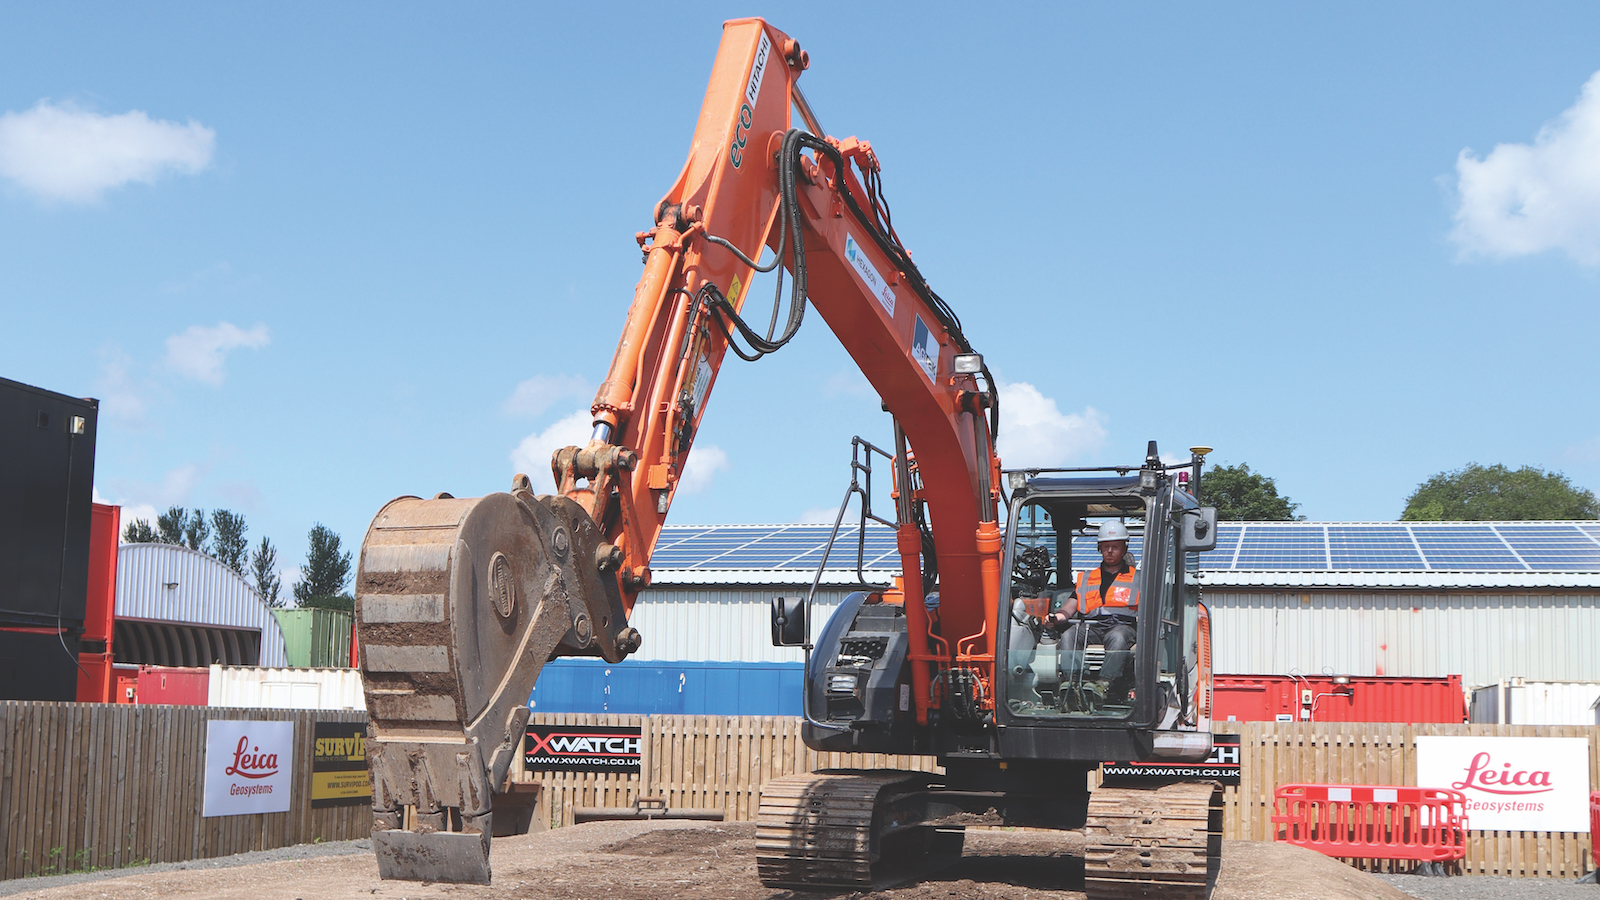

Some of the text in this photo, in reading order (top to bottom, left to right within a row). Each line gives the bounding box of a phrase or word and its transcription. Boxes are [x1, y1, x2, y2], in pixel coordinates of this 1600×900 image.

[748, 37, 769, 101] HITACHI
[730, 103, 752, 169] eco
[225, 735, 279, 779] Leica
[315, 732, 366, 761] SURVIP
[526, 732, 641, 757] XWATCH
[525, 757, 641, 766] WWW.XWATCH.CO.UK
[1103, 768, 1240, 777] WWW.XWATCH.CO.UK
[1451, 752, 1554, 795] Leica
[229, 783, 273, 798] Geosystems
[1463, 798, 1545, 813] Geosystems
